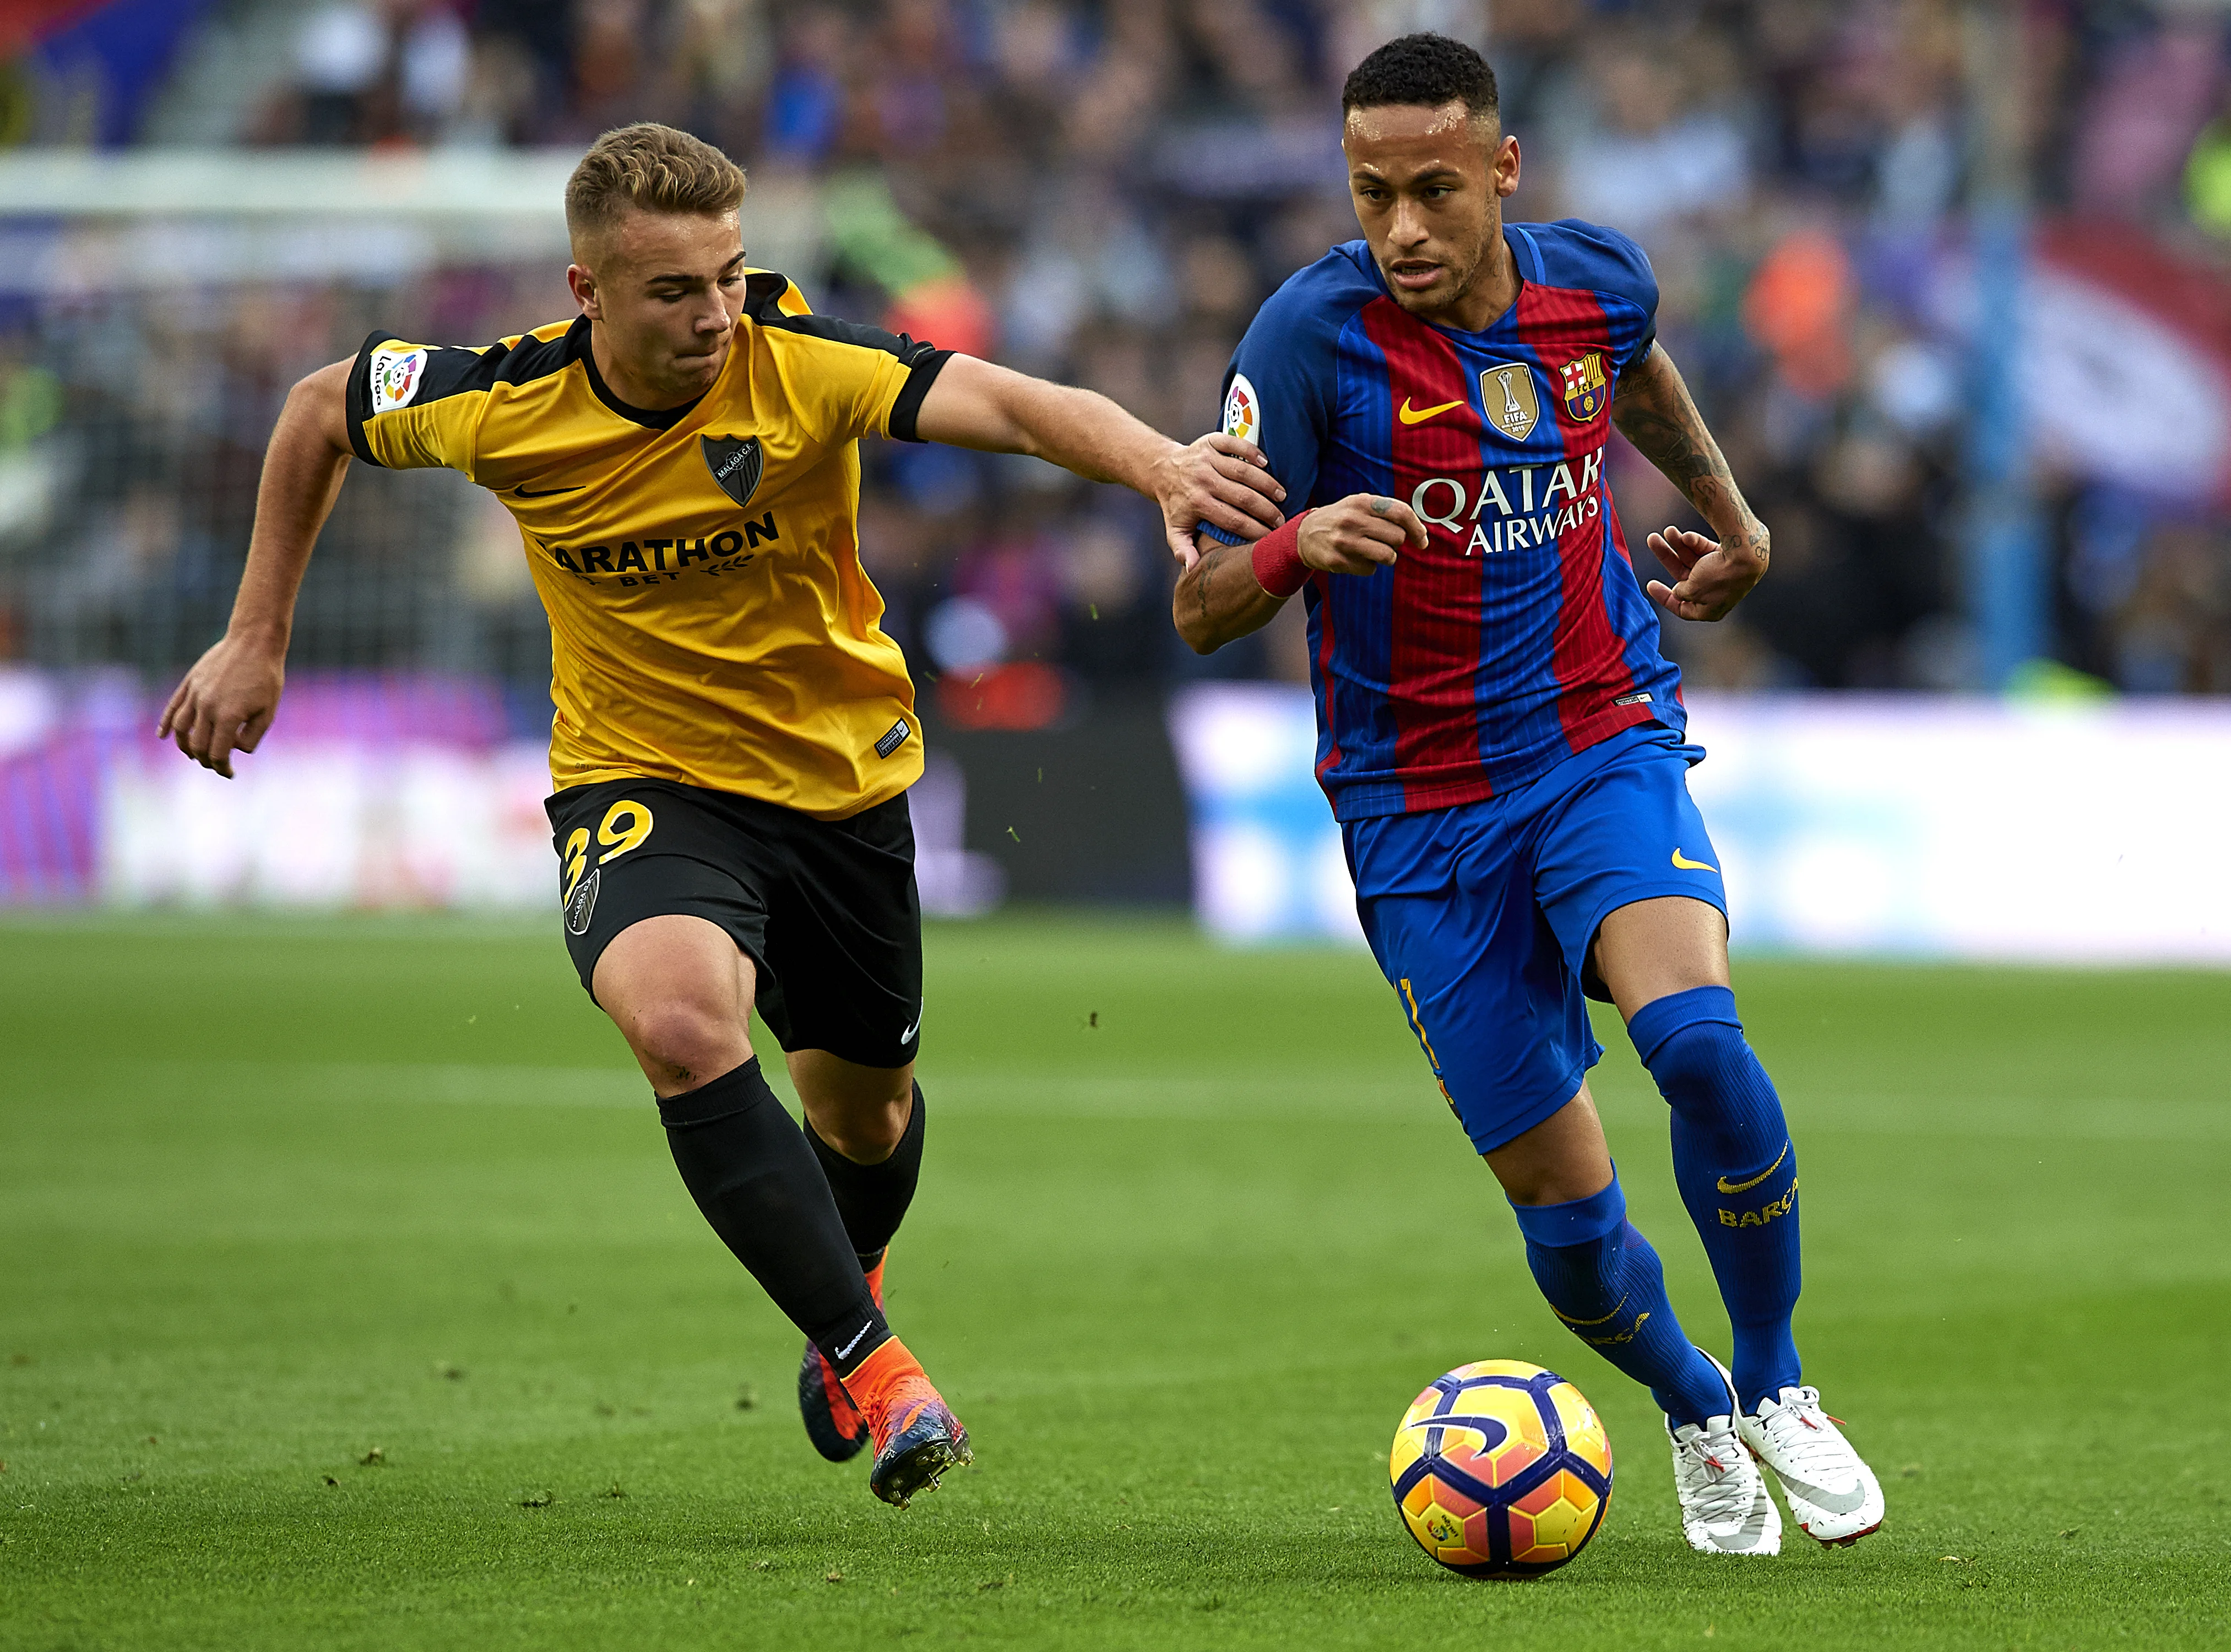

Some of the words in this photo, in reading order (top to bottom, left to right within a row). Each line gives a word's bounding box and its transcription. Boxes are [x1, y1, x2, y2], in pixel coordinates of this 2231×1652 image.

[1577, 381, 1594, 395] FCB
[1503, 411, 1527, 424] FIFA
[742, 443, 753, 454] C.F.
[1412, 447, 1603, 534] QATAR
[1465, 488, 1598, 556] AIRWAYS
[535, 510, 779, 574] ARATHON
[620, 572, 680, 587] BET
[564, 800, 654, 908] 39
